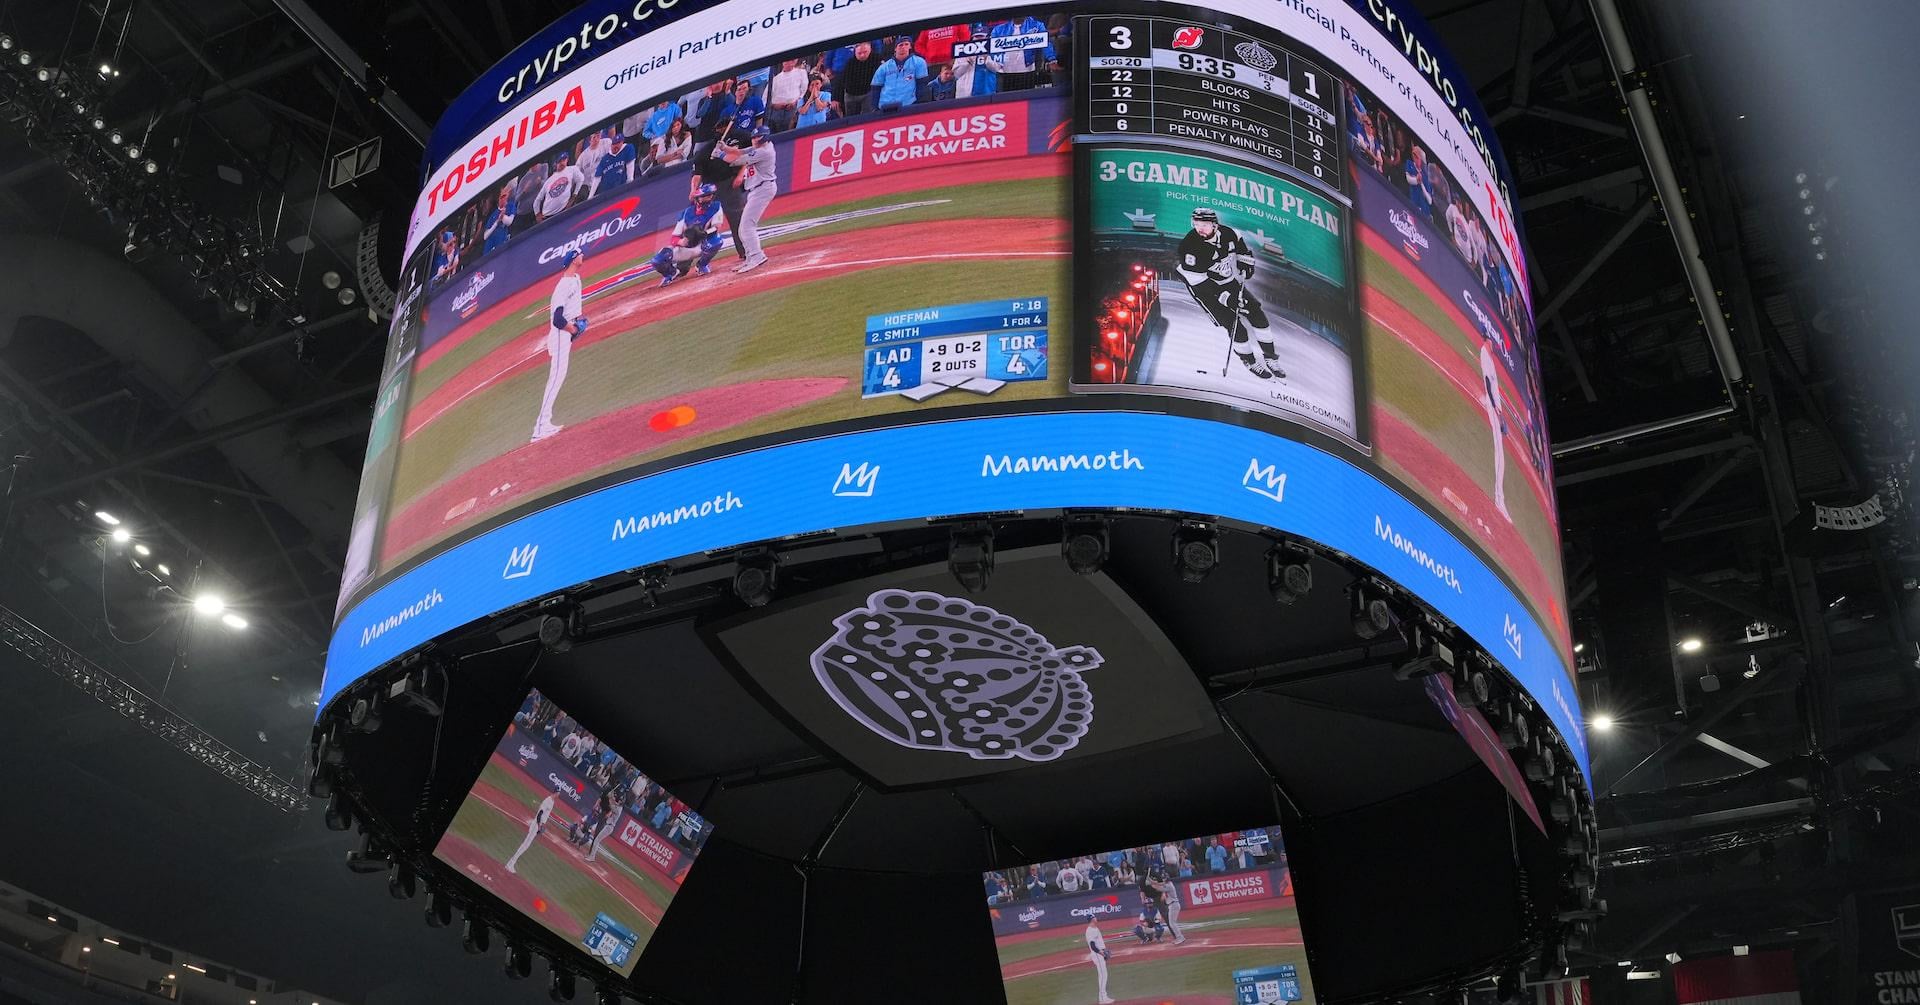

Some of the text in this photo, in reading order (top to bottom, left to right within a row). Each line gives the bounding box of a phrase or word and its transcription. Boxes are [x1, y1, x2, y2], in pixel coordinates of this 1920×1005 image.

[603, 49, 673, 91] Official
[679, 21, 757, 60] Partner
[762, 9, 785, 29] of
[789, 1, 825, 21] the
[954, 40, 987, 57] FOX
[1109, 26, 1132, 50] 3
[1101, 58, 1142, 67] SOG 20
[1178, 53, 1236, 79] 9:35
[1111, 70, 1133, 82] 22
[1258, 72, 1275, 82] PER
[1263, 80, 1271, 91] 3
[1303, 71, 1320, 99] 1
[1340, 25, 1396, 84] Partner
[1398, 81, 1412, 99] of
[1413, 93, 1434, 126] the
[1436, 119, 1452, 145] LA
[1112, 86, 1132, 98] 12
[1201, 79, 1250, 100] BLOCKS
[1116, 102, 1128, 114] 0
[1212, 98, 1241, 113] HITS
[1298, 98, 1315, 112] SOG
[871, 113, 1007, 148] STRAUSS
[1116, 119, 1128, 131] 6
[1183, 108, 1270, 138] POWER PLAYS
[1307, 114, 1322, 131] 11
[1169, 123, 1283, 159] PENALTY MINUTES
[1307, 130, 1324, 147] 10
[427, 85, 586, 218] TOSHIBA
[871, 134, 1006, 165] WORKWEAR
[1312, 148, 1322, 161] 3
[1313, 165, 1323, 177] 0
[1100, 160, 1339, 237] 3-GAME MINI PLAN
[1166, 191, 1291, 226] PICK THE GAMES YOU WANT
[884, 300, 1042, 326] HOFFMAN P: 18
[871, 314, 1042, 342] 2. SMITH 1 FOR 4
[938, 340, 981, 355] 9 0-2
[999, 334, 1036, 351] TOR
[875, 347, 911, 366] LAD
[932, 359, 977, 372] 2 OUTS
[1006, 354, 1026, 375] 4
[882, 366, 901, 388] 4
[981, 449, 1145, 477] Mammoth
[611, 491, 744, 541] Mammoth
[1374, 514, 1462, 595] Mammoth
[359, 588, 444, 648] Mammoth
[640, 832, 674, 860] STRAUSS
[1212, 876, 1263, 892] STRAUSS
[1214, 887, 1265, 900] WORKWEAR
[1878, 987, 1920, 1004] CHA
